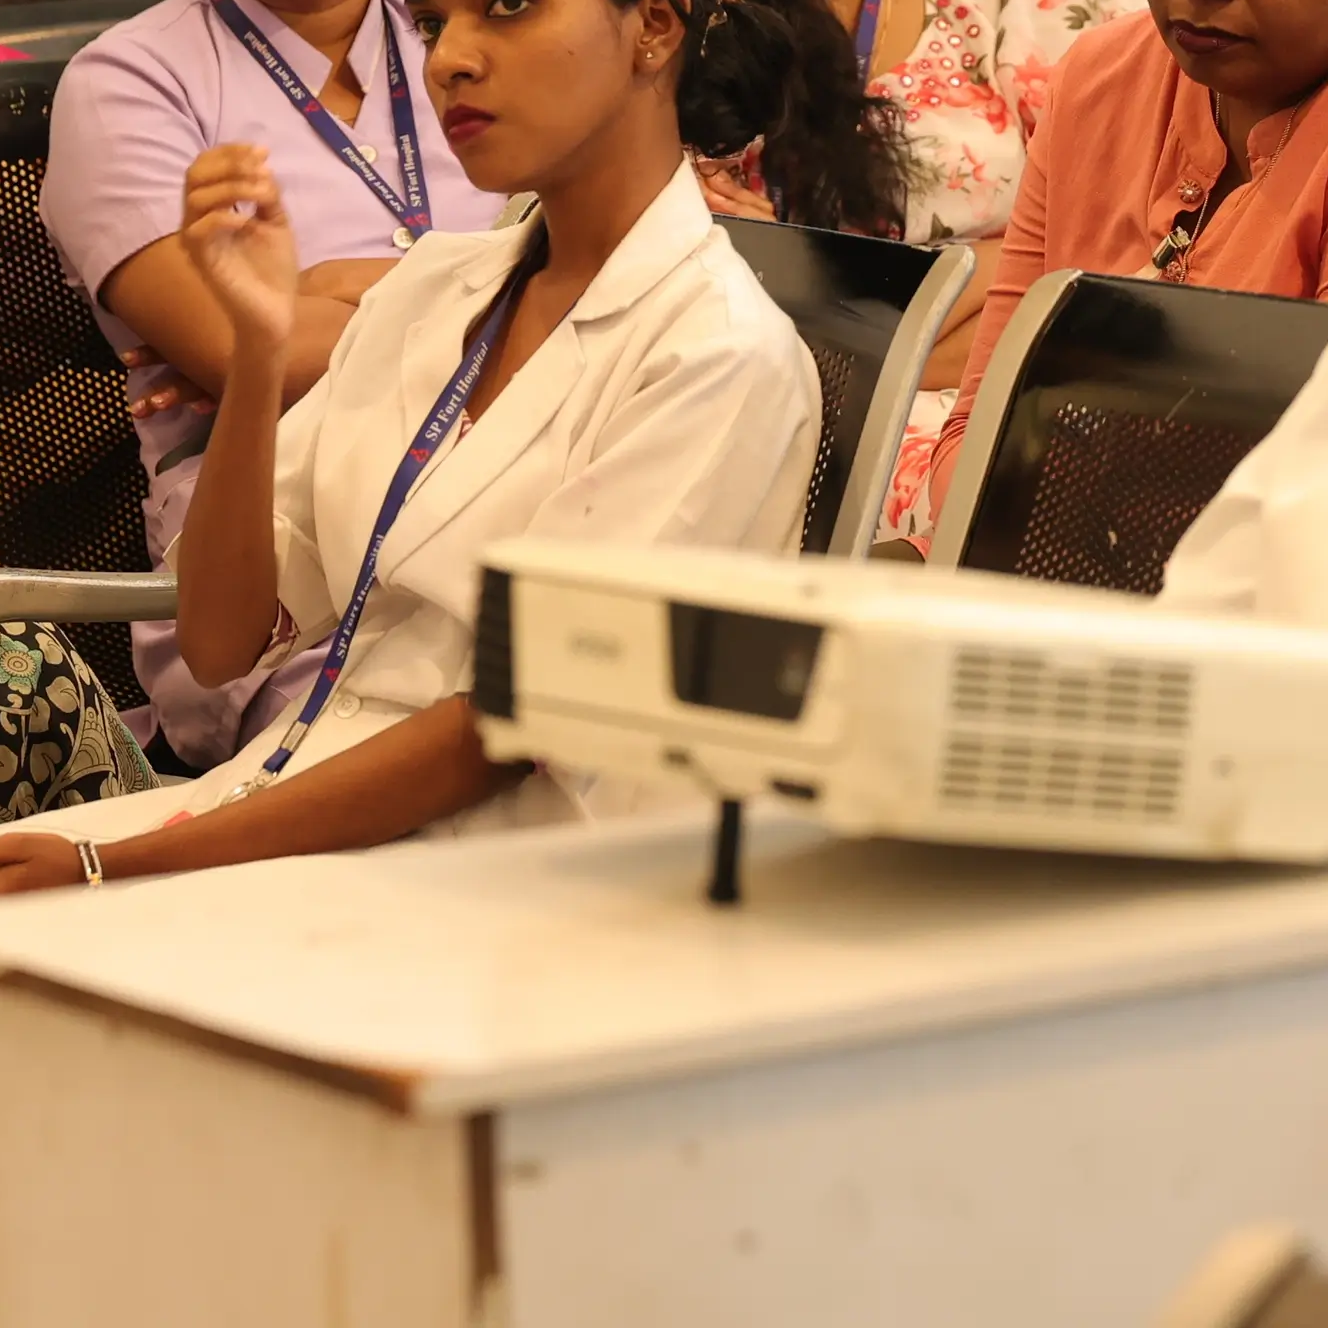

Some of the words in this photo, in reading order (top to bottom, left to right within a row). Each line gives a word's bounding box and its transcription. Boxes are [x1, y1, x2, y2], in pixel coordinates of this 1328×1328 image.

[244, 31, 280, 70] Hospital
[275, 65, 295, 90] Fort
[287, 86, 306, 101] SP
[342, 147, 378, 182] Hospital
[399, 134, 417, 172] Hospital
[374, 179, 394, 201] Fort
[407, 170, 422, 193] Fort
[389, 198, 404, 213] SP
[410, 191, 423, 208] SP
[425, 421, 444, 442] SP
[437, 393, 463, 424] Fort
[455, 341, 490, 395] Hospital
[336, 641, 349, 660] SP
[343, 605, 360, 636] Fort
